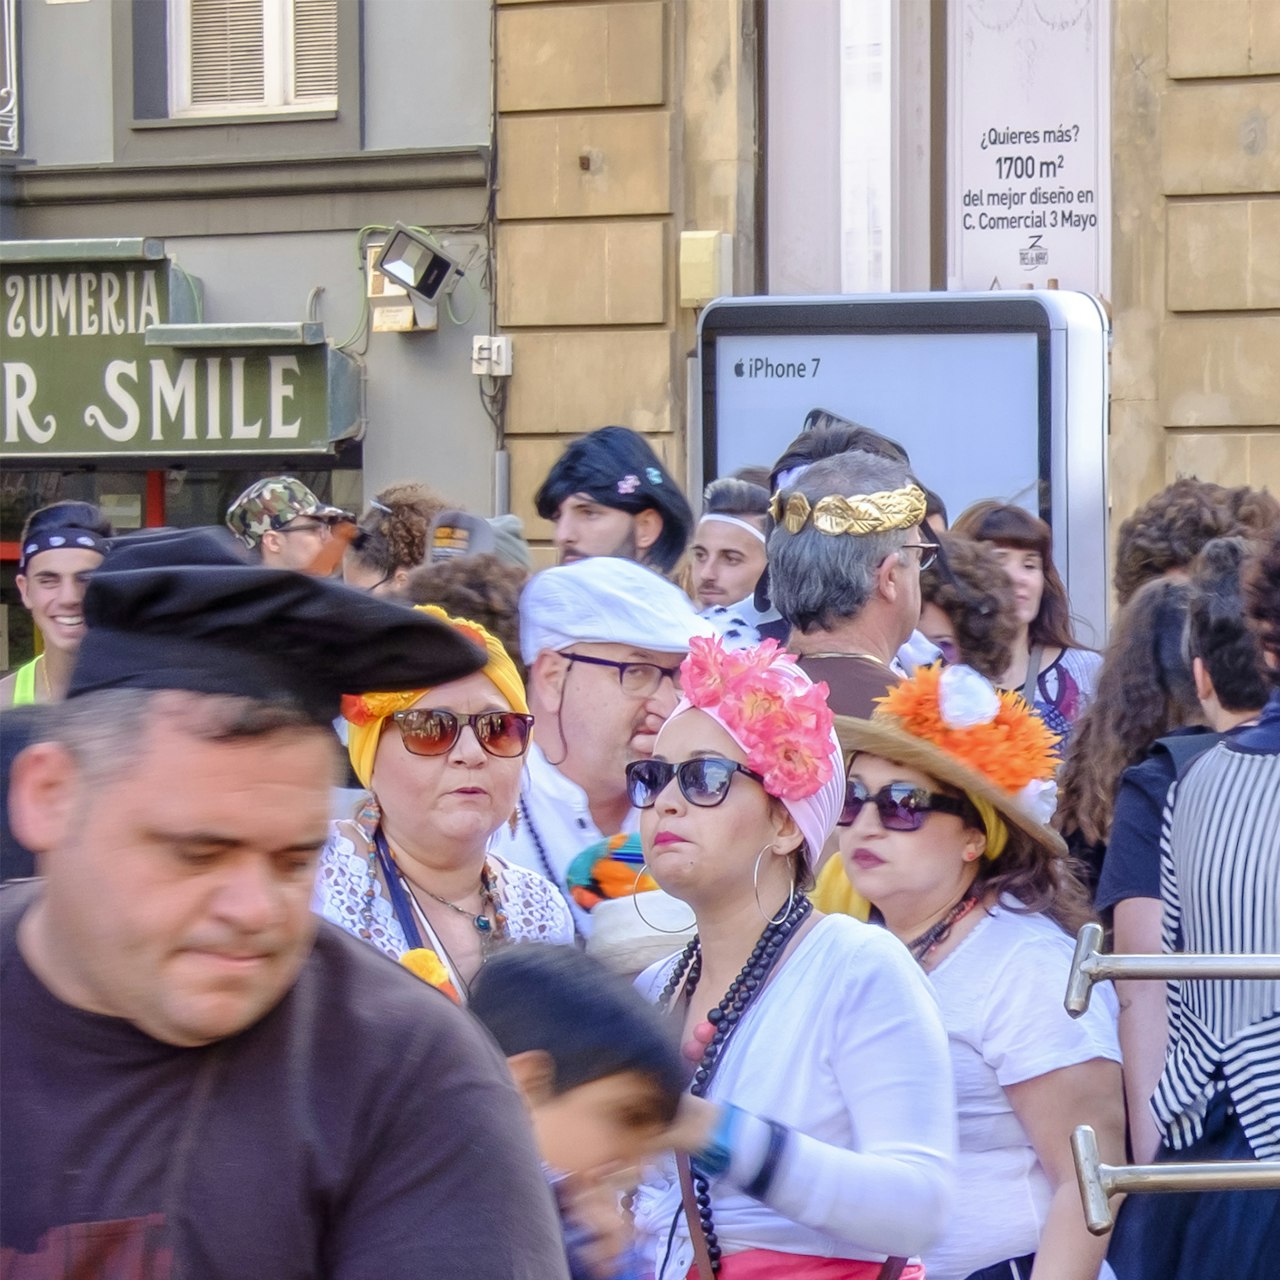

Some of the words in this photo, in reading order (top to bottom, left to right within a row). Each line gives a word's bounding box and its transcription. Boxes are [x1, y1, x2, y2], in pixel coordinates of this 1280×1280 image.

[980, 126, 1040, 150] ¿Quieres
[1043, 124, 1080, 143] más?
[995, 155, 1035, 179] 1700
[963, 189, 984, 207] del
[987, 187, 1027, 210] mejor
[1030, 186, 1074, 205] diseño
[1077, 190, 1094, 203] en
[963, 213, 976, 230] C.
[979, 210, 1047, 230] Comercial
[1050, 210, 1058, 228] 3
[1061, 210, 1097, 232] Mayo
[749, 357, 806, 378] iPhone
[811, 358, 821, 378] 7
[84, 355, 302, 442] SMILE
